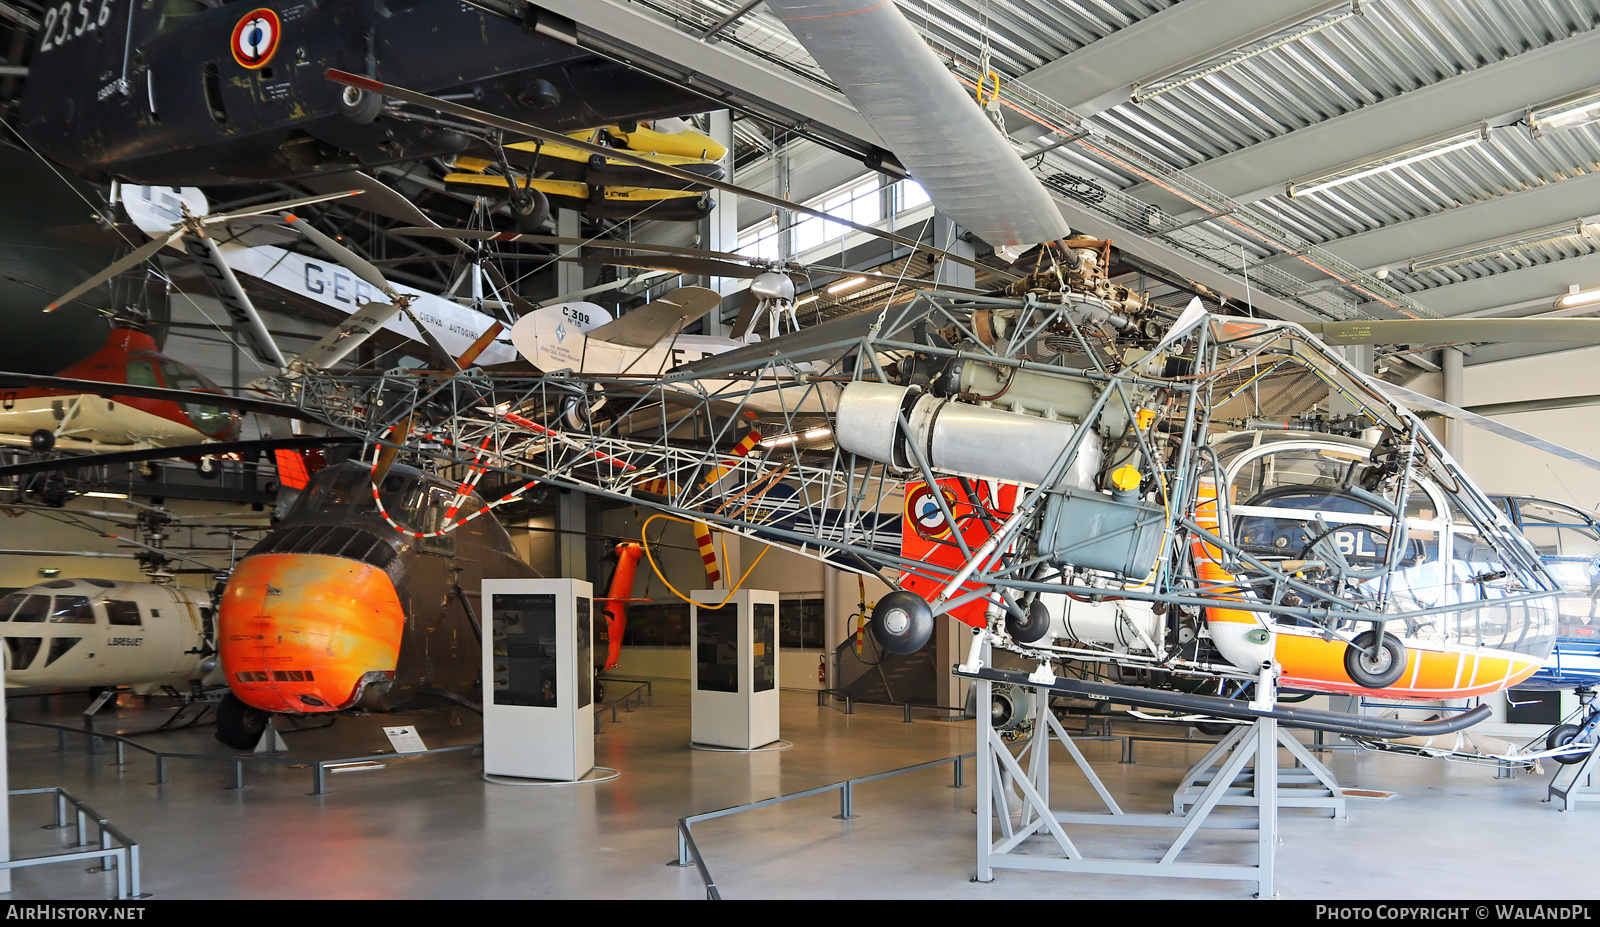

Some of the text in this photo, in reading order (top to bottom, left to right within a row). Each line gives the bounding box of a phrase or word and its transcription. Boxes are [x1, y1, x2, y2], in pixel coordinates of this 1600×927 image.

[419, 311, 479, 341] CIERVA AUTOGIRO
[562, 306, 590, 325] C.302
